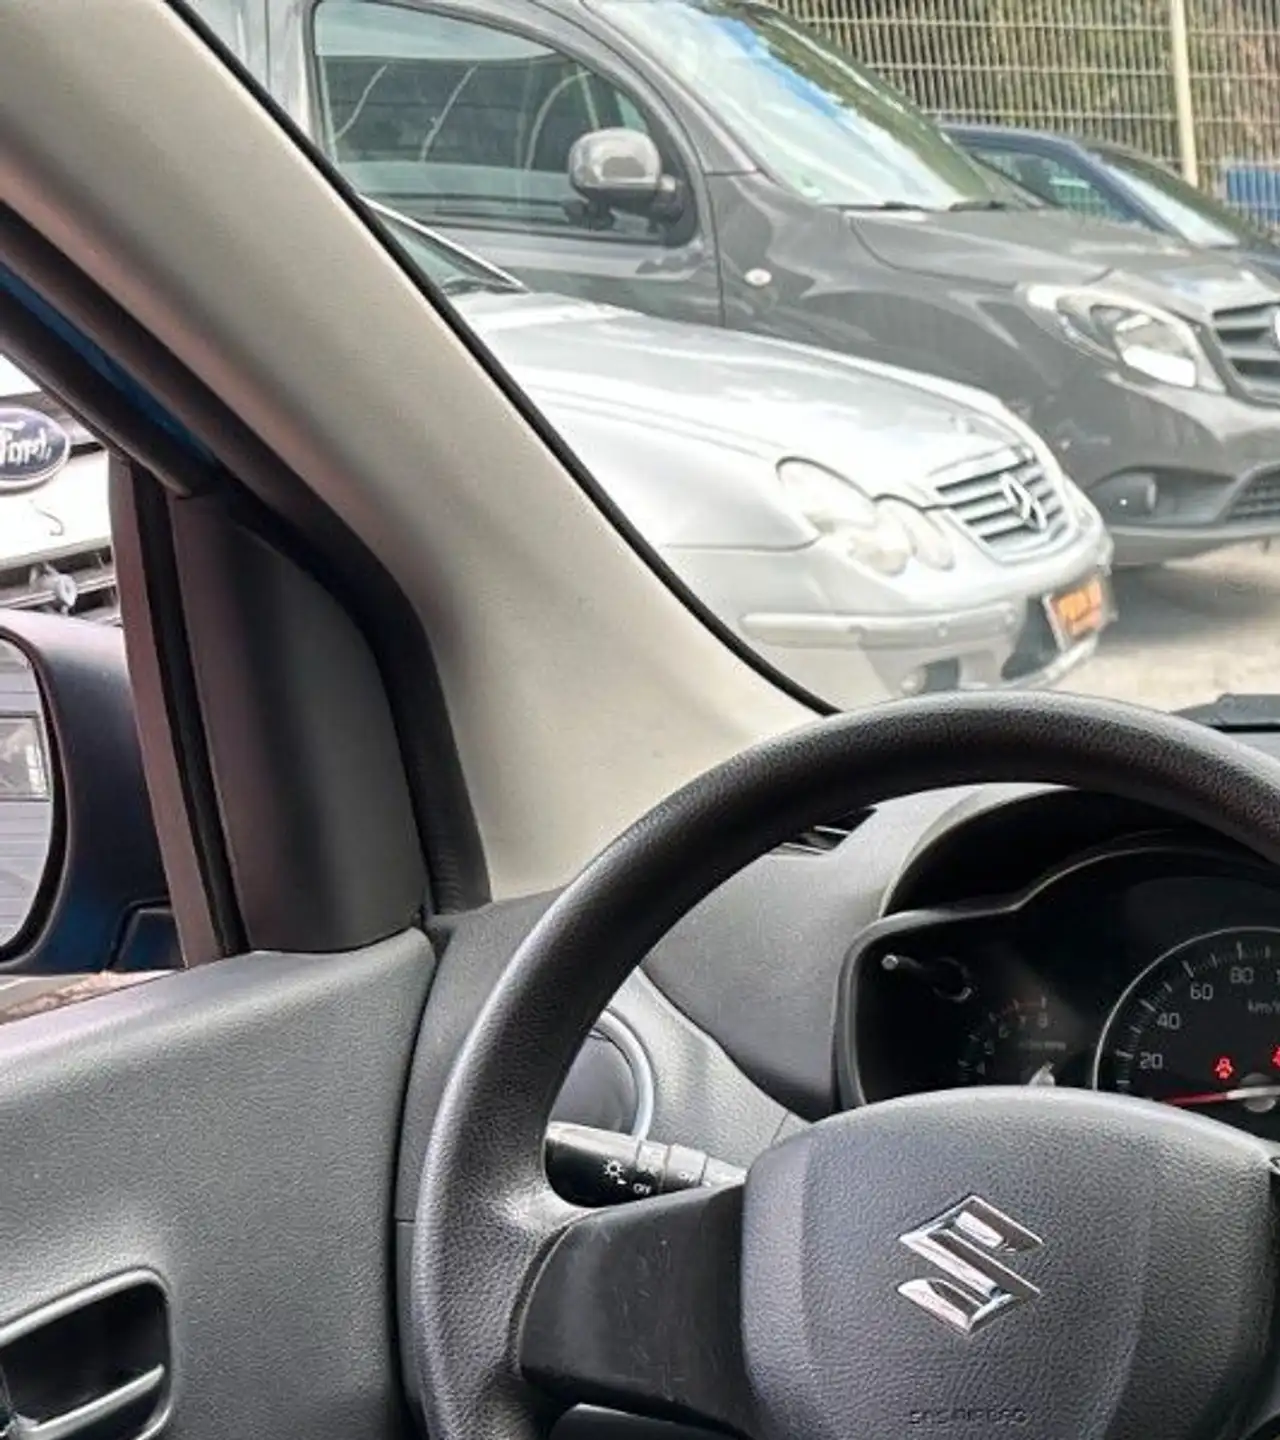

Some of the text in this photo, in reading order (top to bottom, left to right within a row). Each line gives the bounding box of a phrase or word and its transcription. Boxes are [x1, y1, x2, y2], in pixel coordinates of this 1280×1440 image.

[1230, 967, 1255, 985] 80
[1190, 984, 1214, 1001] 60
[1156, 1013, 1181, 1029] 40
[1139, 1053, 1163, 1070] 20
